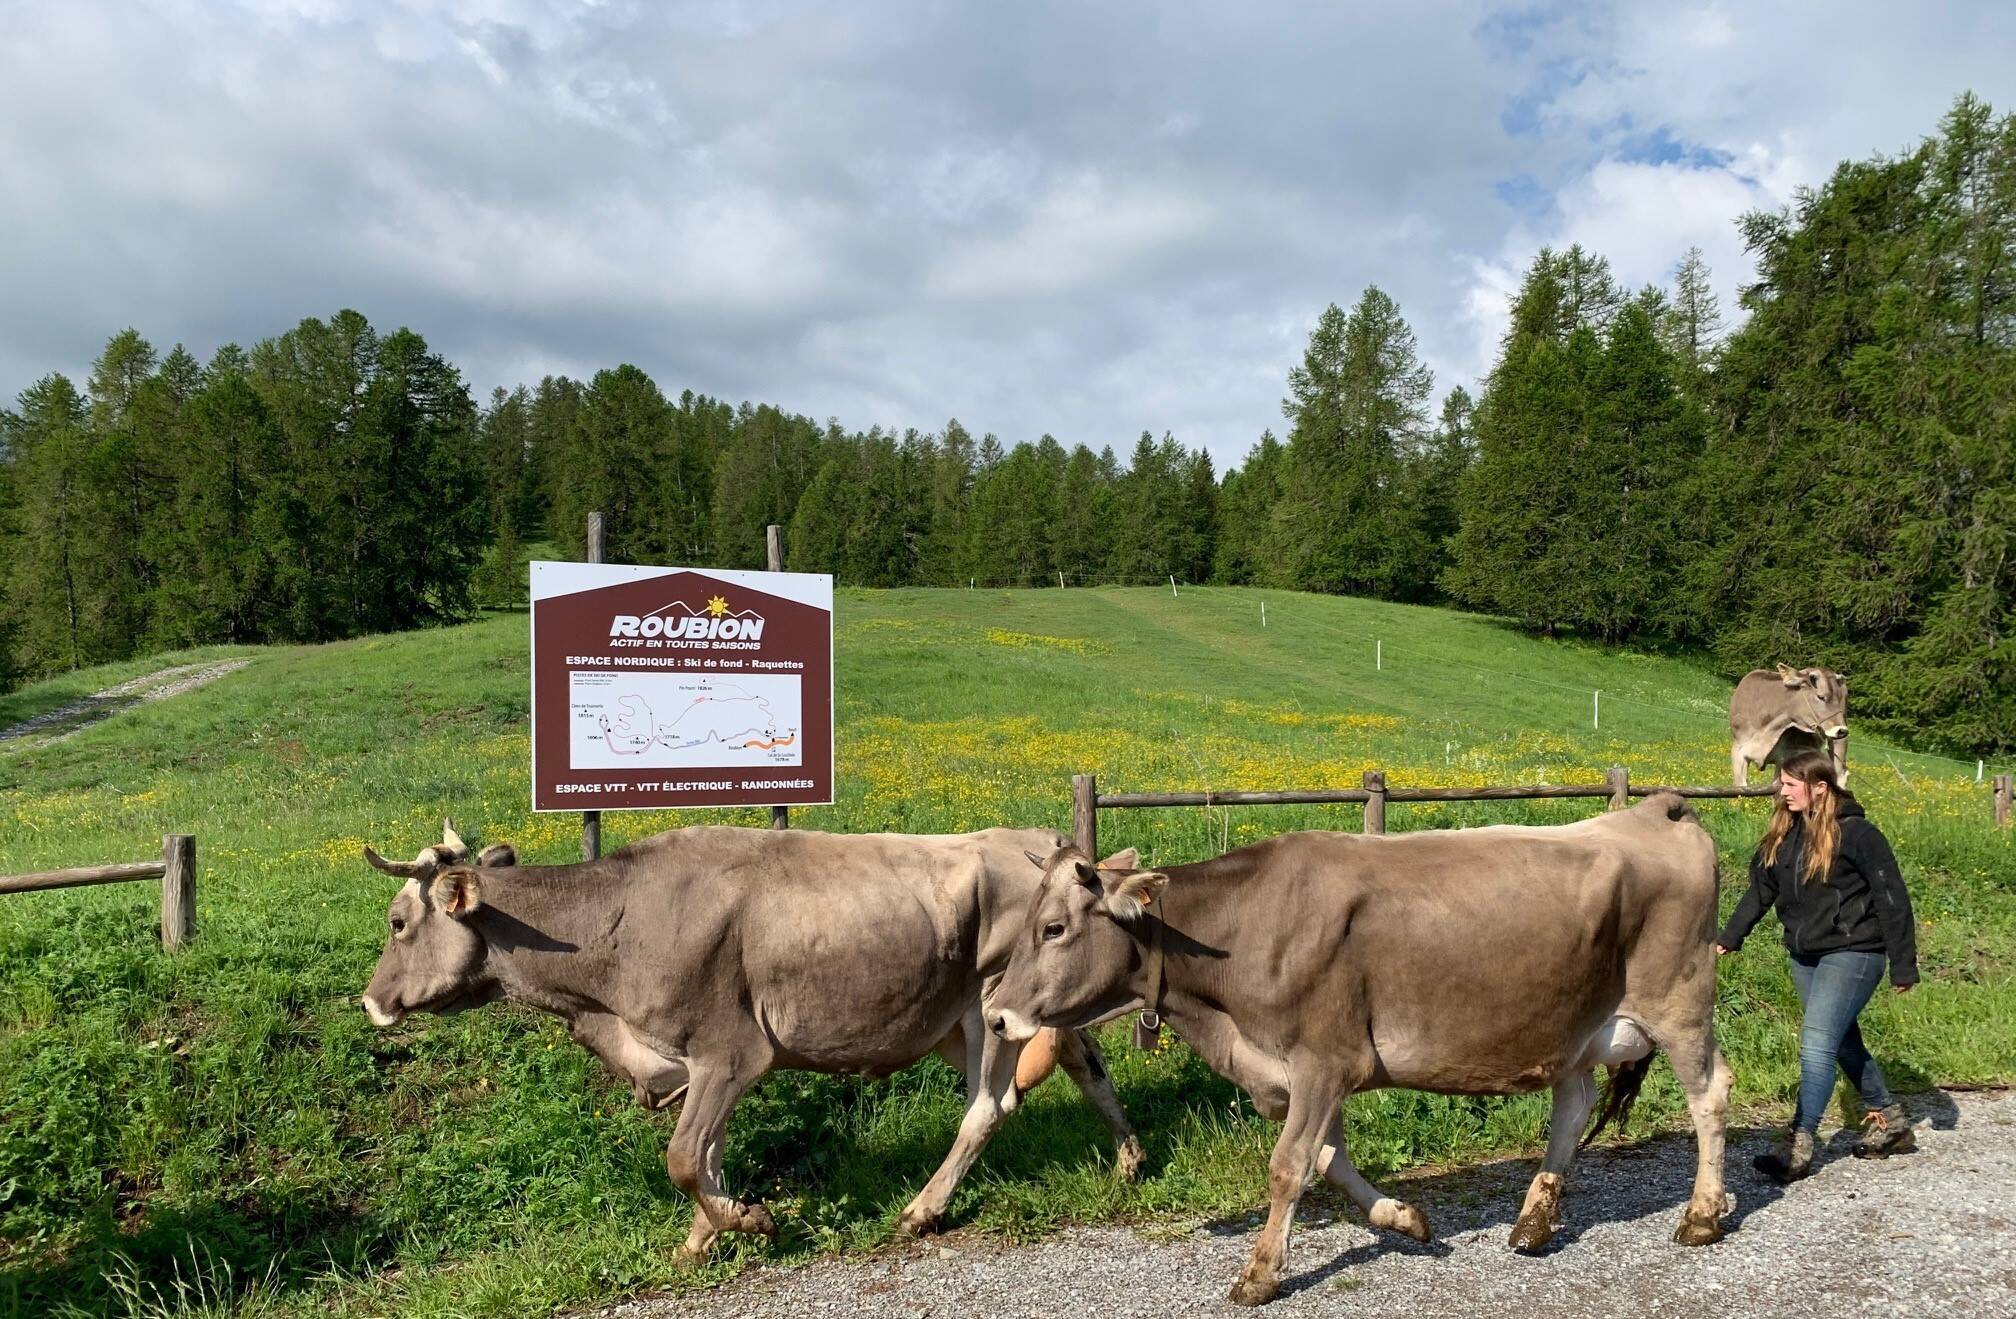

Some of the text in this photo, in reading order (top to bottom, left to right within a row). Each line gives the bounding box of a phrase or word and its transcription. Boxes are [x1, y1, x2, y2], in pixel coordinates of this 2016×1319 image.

[609, 615, 765, 641] ROUBION
[609, 638, 761, 650] ACTIF EN TOUTES SAISONS
[565, 655, 611, 665] ESPACE
[614, 657, 675, 667] NORDIQUE
[683, 658, 701, 667] Ski
[703, 659, 718, 668] de
[720, 659, 743, 668] fond
[752, 660, 804, 670] Raquettes
[555, 783, 602, 793] ESPACE
[604, 783, 628, 792] VTT
[637, 782, 660, 792] VTT
[662, 781, 733, 791] ÉLECTRIQUE
[741, 778, 814, 790] RANDONNÉES
